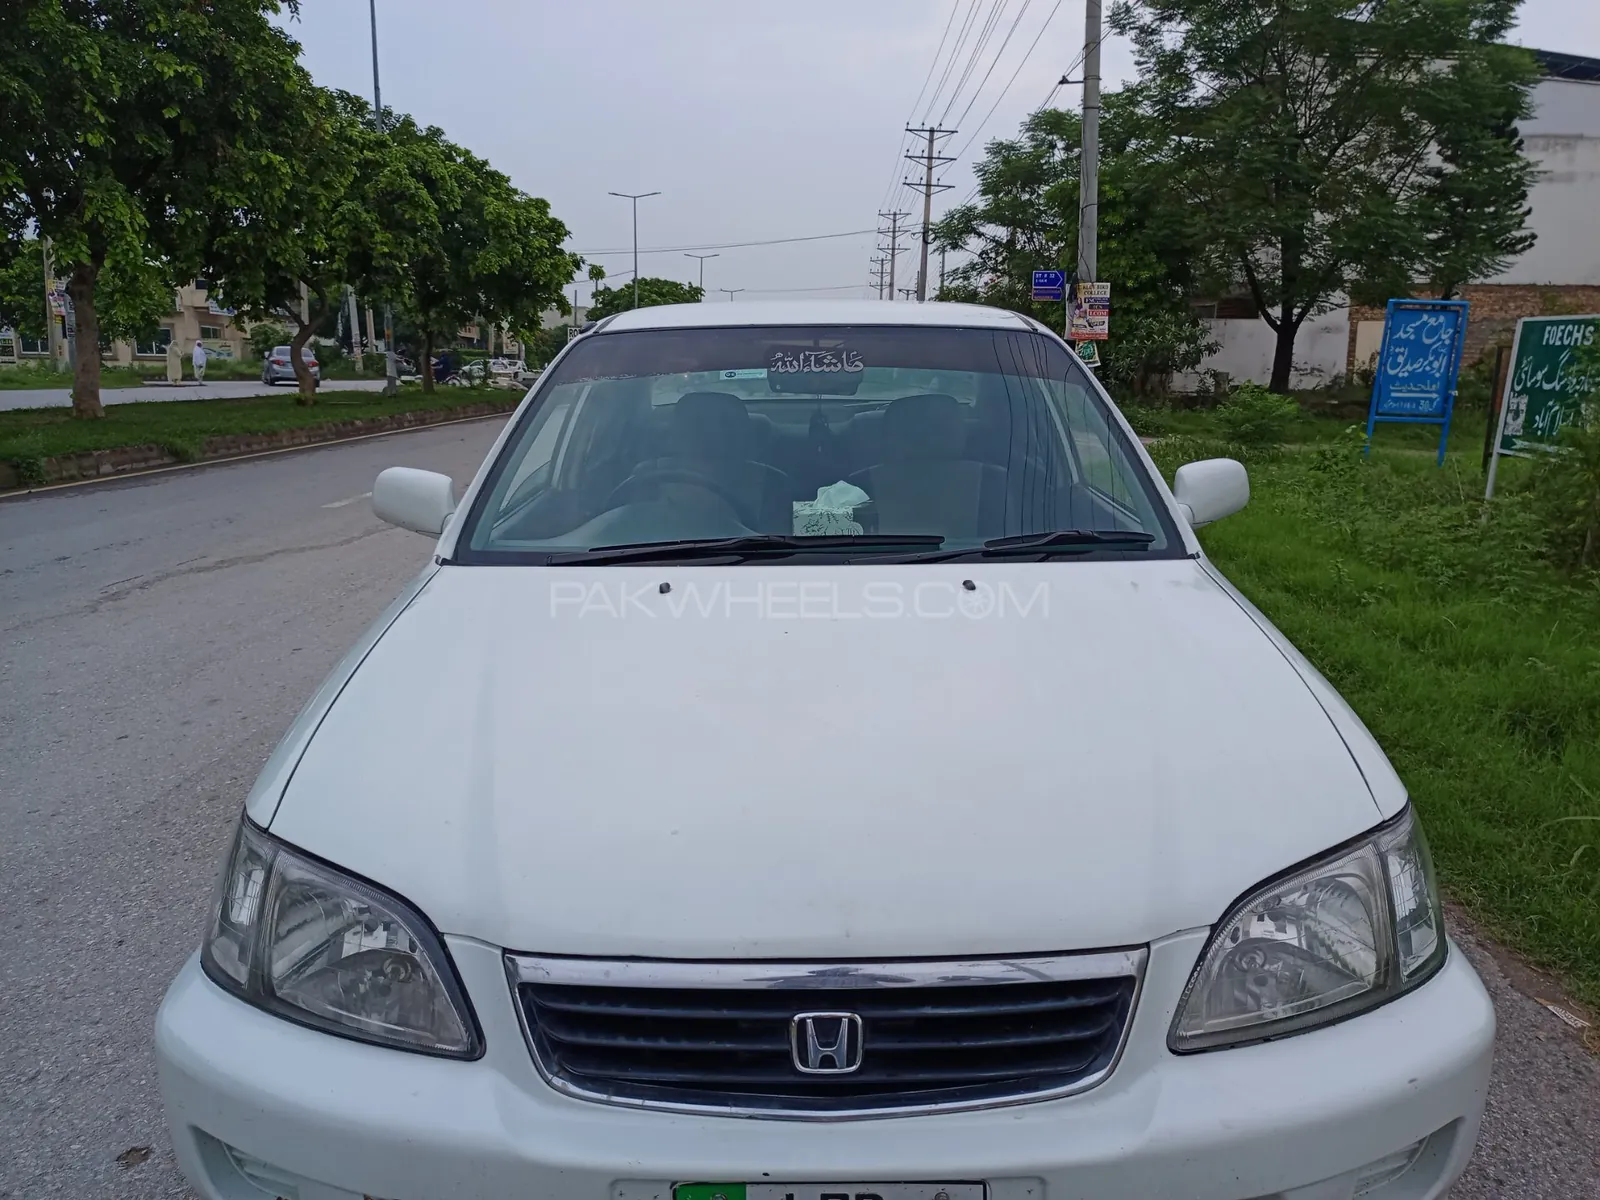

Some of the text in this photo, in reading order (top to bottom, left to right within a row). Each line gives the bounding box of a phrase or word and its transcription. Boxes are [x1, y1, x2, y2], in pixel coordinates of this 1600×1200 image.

[1392, 313, 1454, 344] جامع مسجد
[1542, 324, 1595, 346] FOECHS
